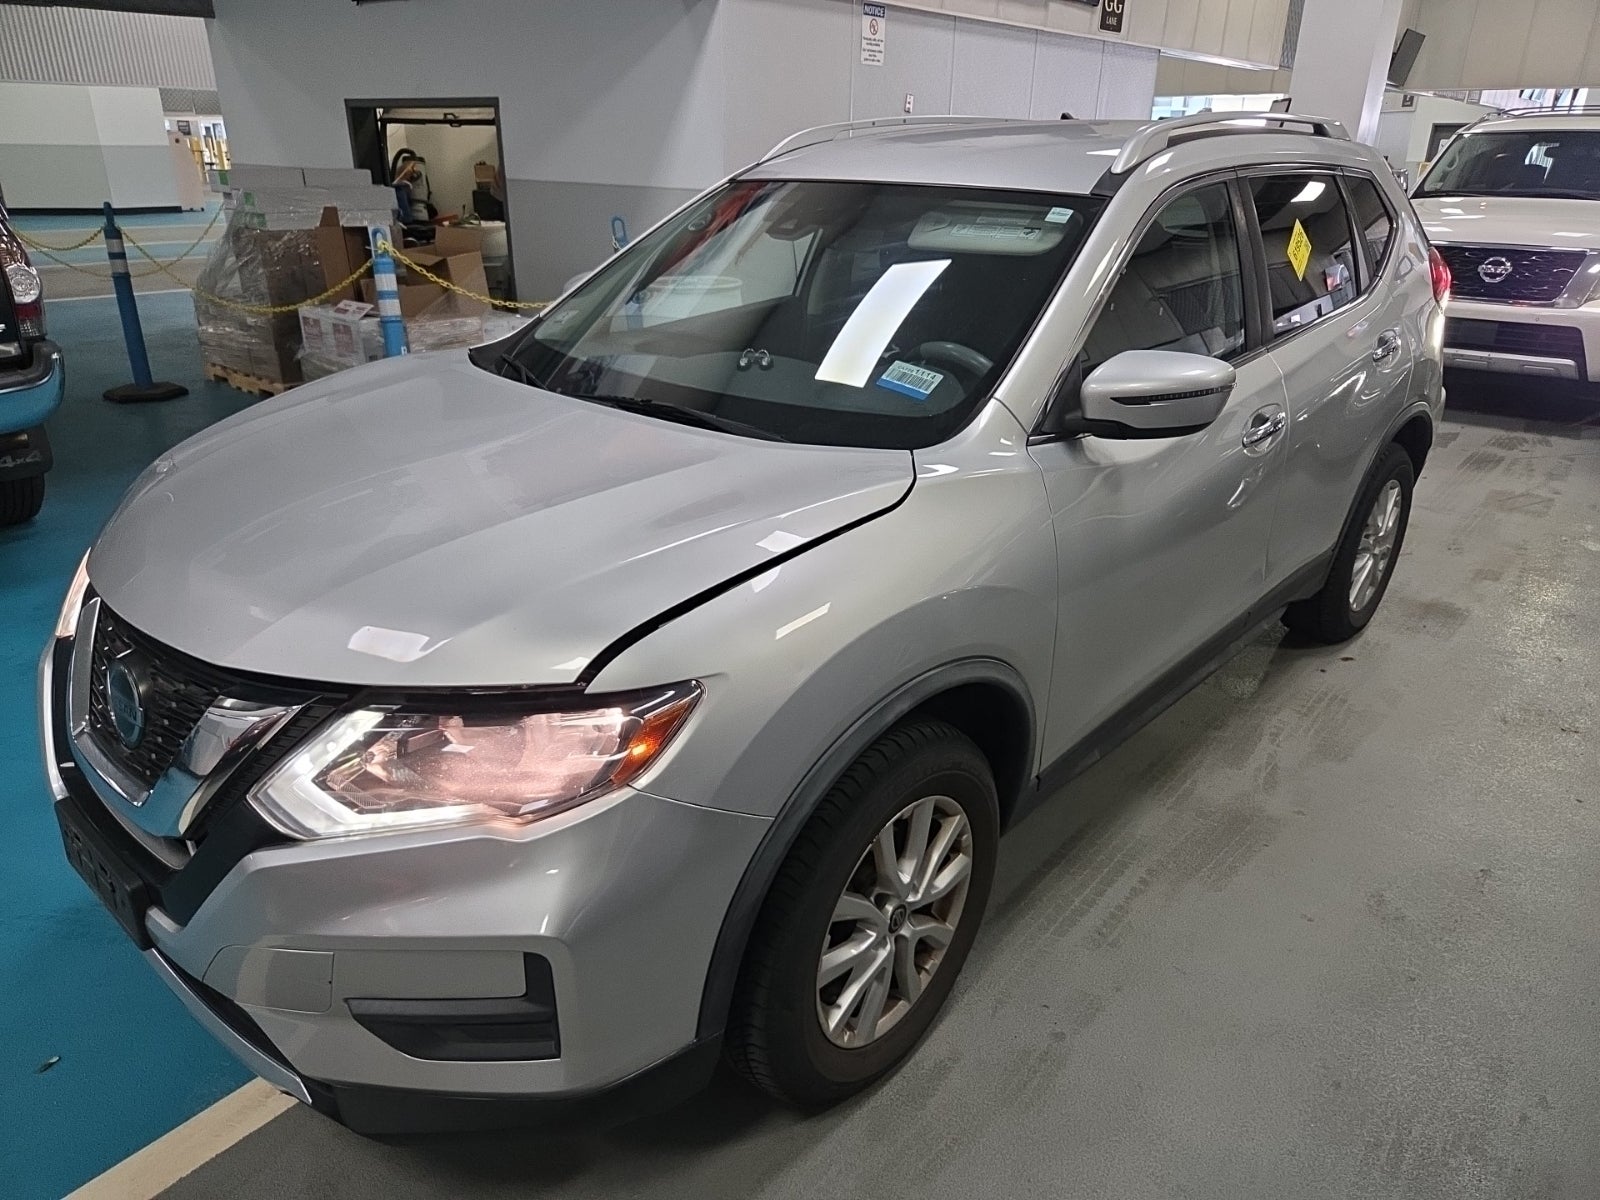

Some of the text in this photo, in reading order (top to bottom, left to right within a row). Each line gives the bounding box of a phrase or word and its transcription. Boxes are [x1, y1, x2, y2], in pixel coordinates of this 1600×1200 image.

[864, 4, 885, 17] NOTICE
[1105, 0, 1123, 13] GG
[1106, 16, 1118, 25] LANE
